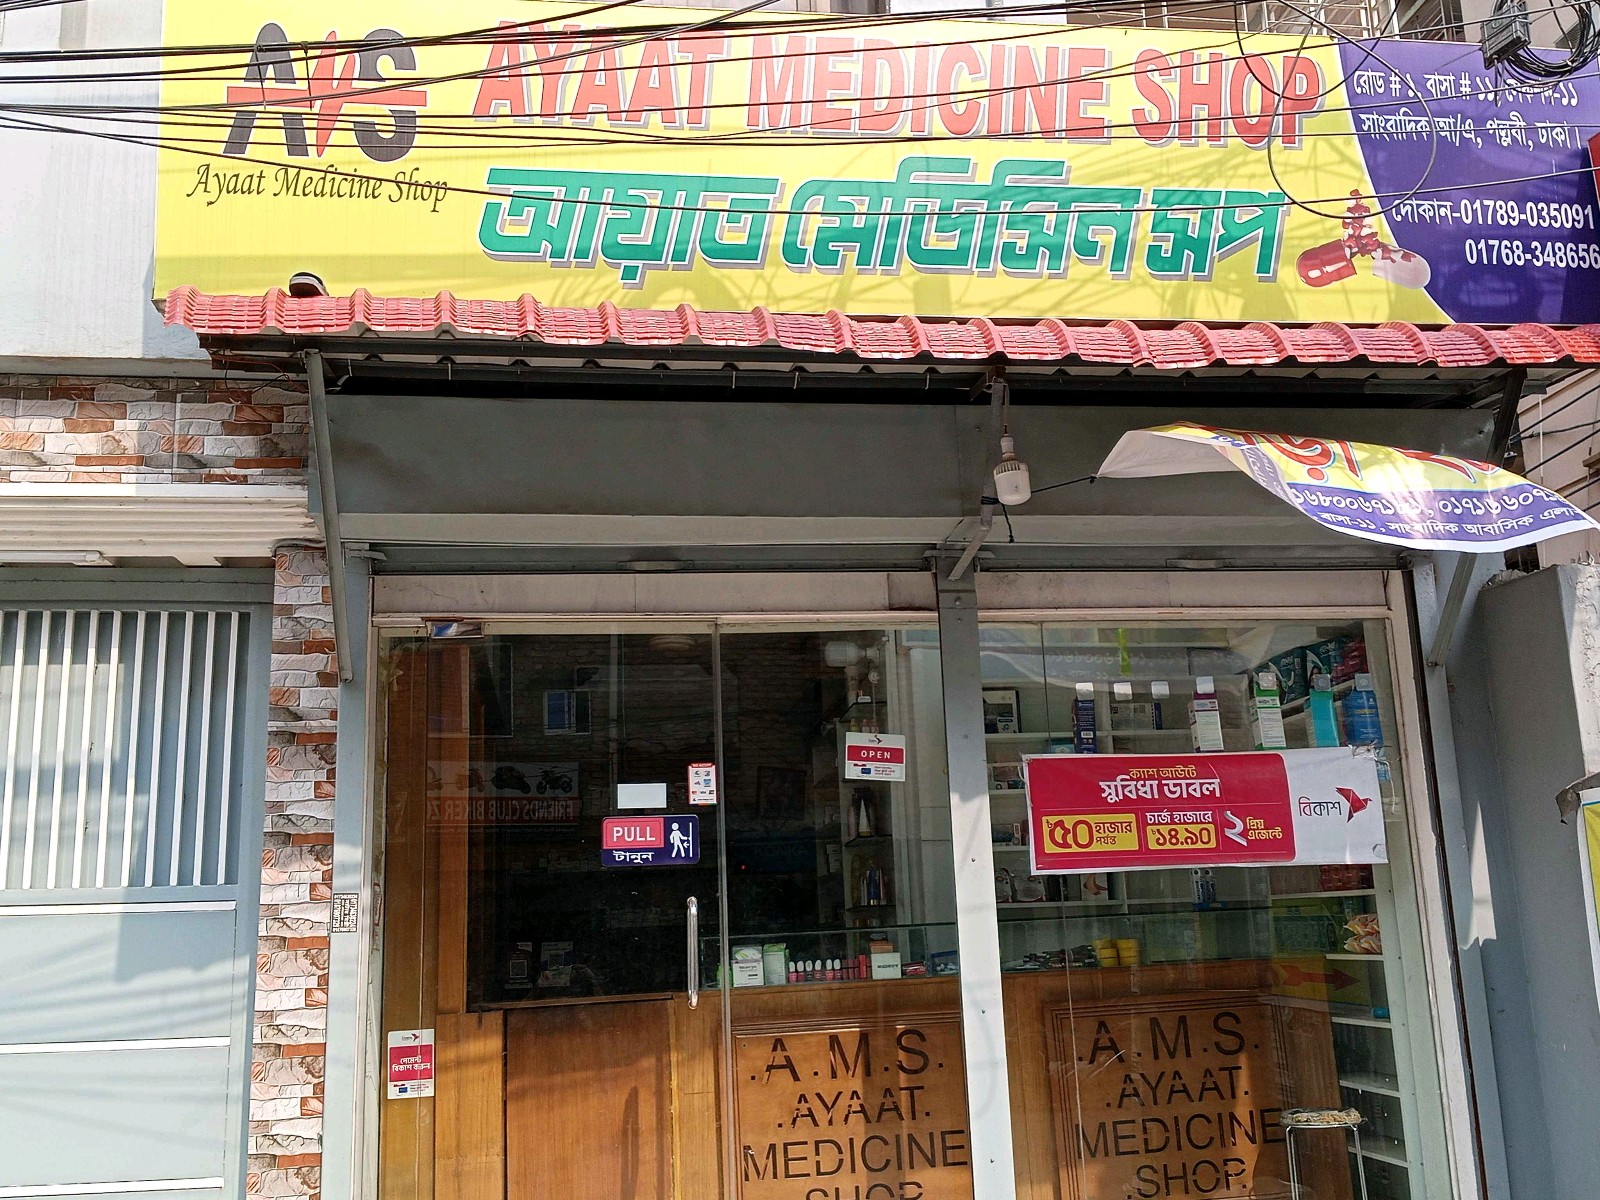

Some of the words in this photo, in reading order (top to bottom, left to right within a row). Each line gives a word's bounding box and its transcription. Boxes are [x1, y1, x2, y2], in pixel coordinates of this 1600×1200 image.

[472, 20, 727, 126] AYAAT
[747, 36, 1110, 142] MEDICINE
[1131, 47, 1324, 149] SHOP
[1353, 68, 1386, 96] রোড
[1423, 71, 1457, 100] বাসা
[1459, 71, 1472, 100] #
[1358, 106, 1430, 142] সাংবাদিক
[187, 163, 267, 207] Ayaat
[273, 166, 384, 202] Medicine
[389, 167, 449, 214] Shop
[477, 167, 784, 289] আয়াত
[783, 154, 1147, 279] মেডিসিন
[1465, 239, 1600, 271] 01768-348656
[1462, 514, 1533, 537] আবাসিক
[860, 749, 892, 760] OPEN
[1129, 767, 1159, 780] ক্যাশ
[1159, 764, 1198, 780] আউটে
[1099, 775, 1160, 804] সুবিধা
[1162, 777, 1222, 799] ডাবল
[1145, 810, 1172, 825] চার্জ
[1173, 810, 1214, 824] হাজারে
[1298, 796, 1342, 817] বিকাশ
[612, 824, 656, 842] PULL
[1095, 820, 1133, 836] হাজার
[1223, 809, 1248, 848] ২
[1246, 816, 1265, 830] প্রিয়
[1247, 826, 1283, 841] এজেন্টে
[1095, 833, 1118, 847] পর্যন্ত
[612, 849, 655, 864] টানুন
[1075, 1107, 1286, 1160] MEDICINE
[743, 1129, 969, 1183] MEDICINE
